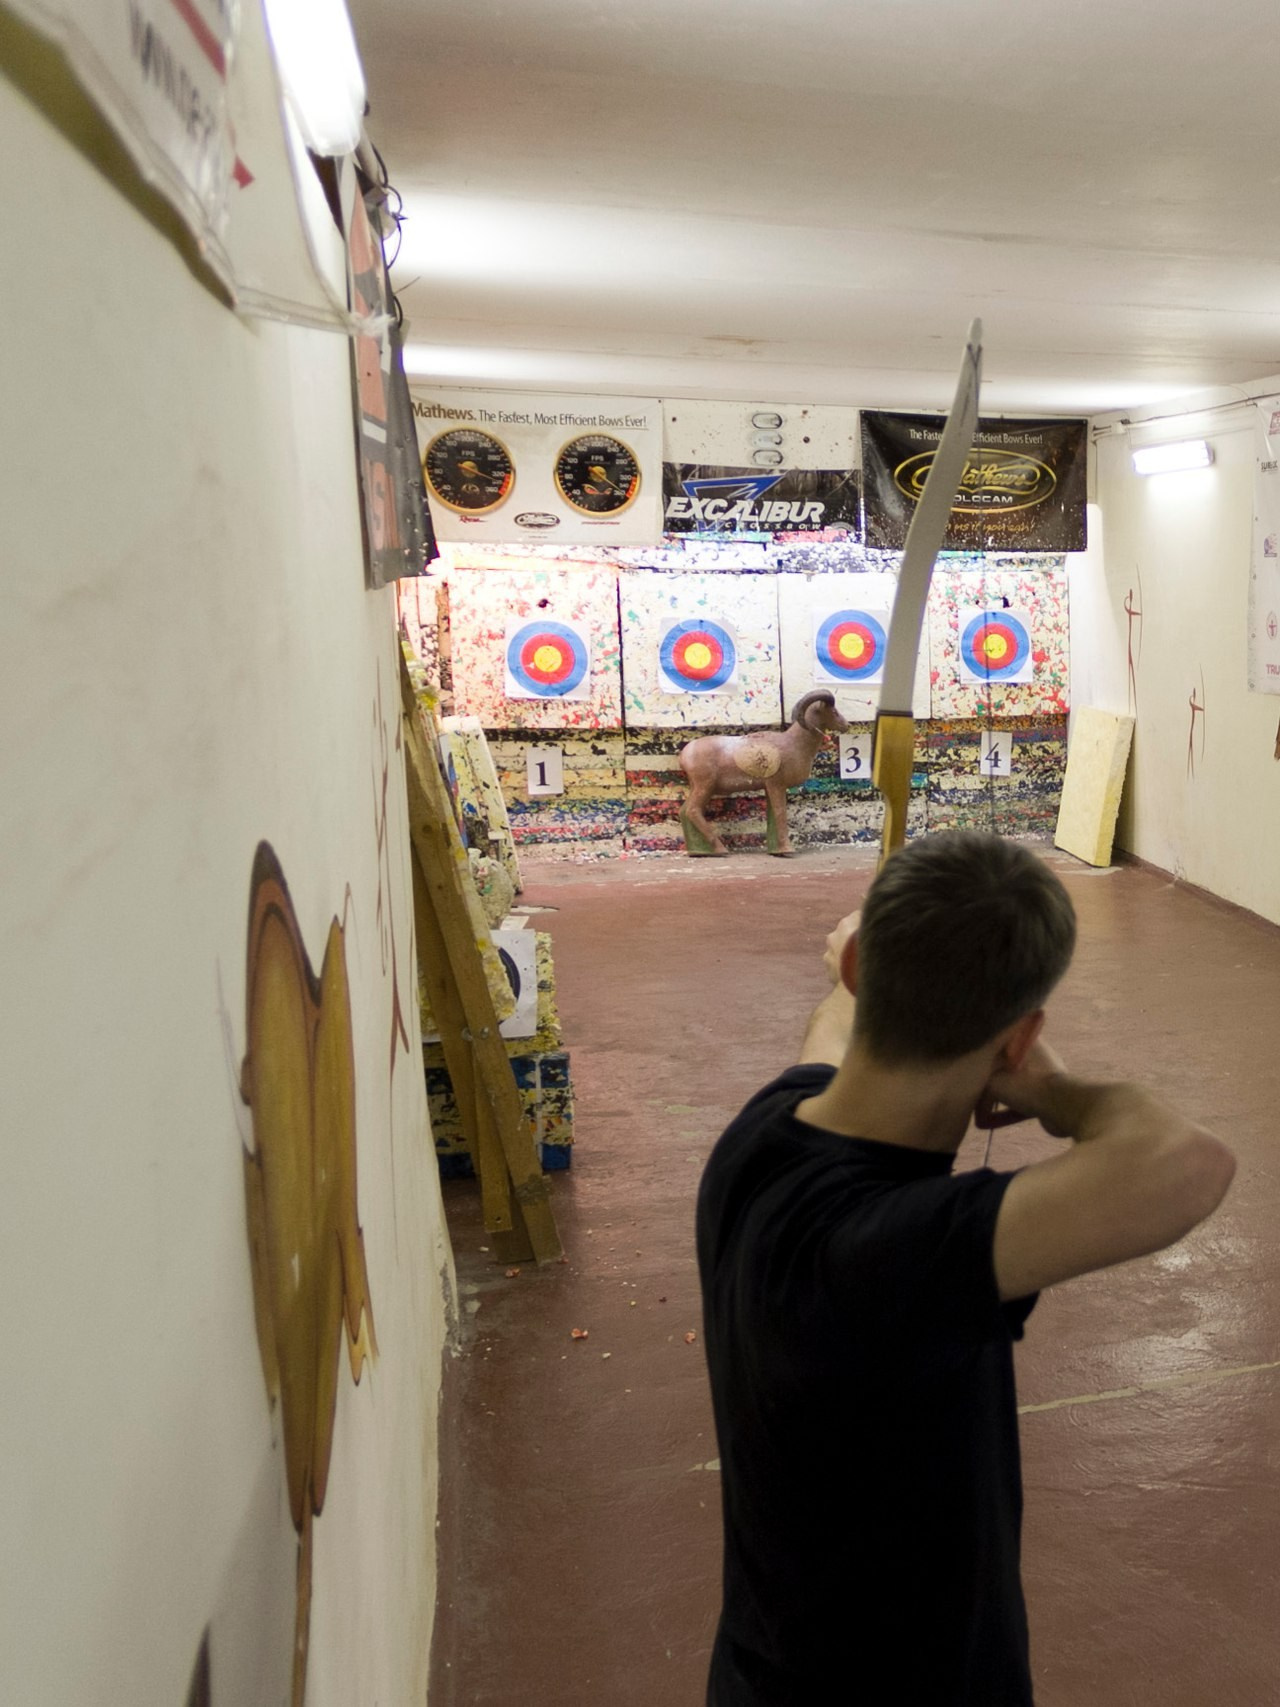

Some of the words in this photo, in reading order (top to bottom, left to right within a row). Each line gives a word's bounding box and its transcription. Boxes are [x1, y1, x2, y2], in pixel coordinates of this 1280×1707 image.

[479, 410, 497, 423] The
[499, 410, 533, 426] Fastest,
[534, 413, 558, 426] Most
[559, 414, 597, 427] Efficient
[599, 416, 624, 427] Bows
[625, 416, 647, 428] Ever!
[909, 429, 923, 440] The
[1003, 433, 1023, 444] Bows
[1024, 434, 1043, 444] Ever!
[665, 496, 826, 523] EXCALIBUR
[954, 494, 1013, 503] OLOCAM
[845, 746, 862, 773] 3
[985, 742, 1002, 769] 4
[535, 761, 551, 787] 1
